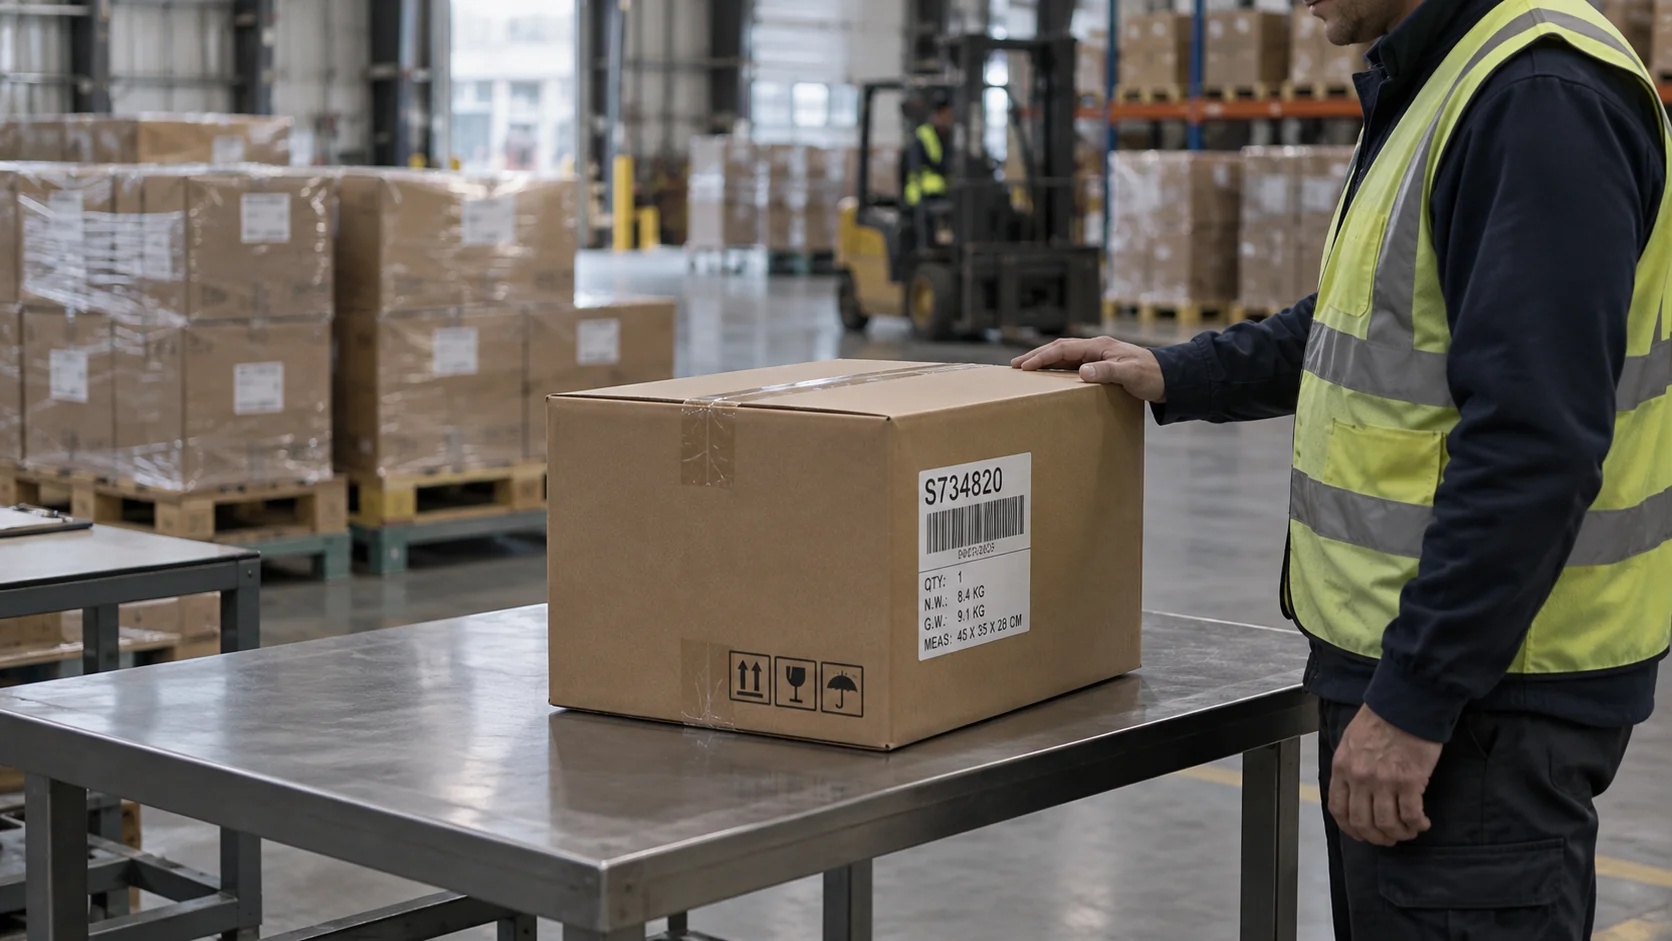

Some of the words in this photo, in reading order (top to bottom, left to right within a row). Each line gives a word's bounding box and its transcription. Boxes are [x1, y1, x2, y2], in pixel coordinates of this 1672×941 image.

[925, 466, 1003, 506] S734820
[924, 574, 946, 592] QTY:
[958, 571, 962, 583] 1
[957, 588, 970, 603] 8.4
[973, 585, 985, 600] KG
[957, 608, 970, 623] 9.1
[973, 604, 985, 619] KG
[924, 633, 952, 652] MEAS:
[957, 628, 968, 642] 45
[969, 626, 975, 640] X
[978, 622, 988, 637] 35
[989, 620, 996, 634] X
[997, 617, 1007, 632] 28
[1009, 614, 1023, 629] CM
